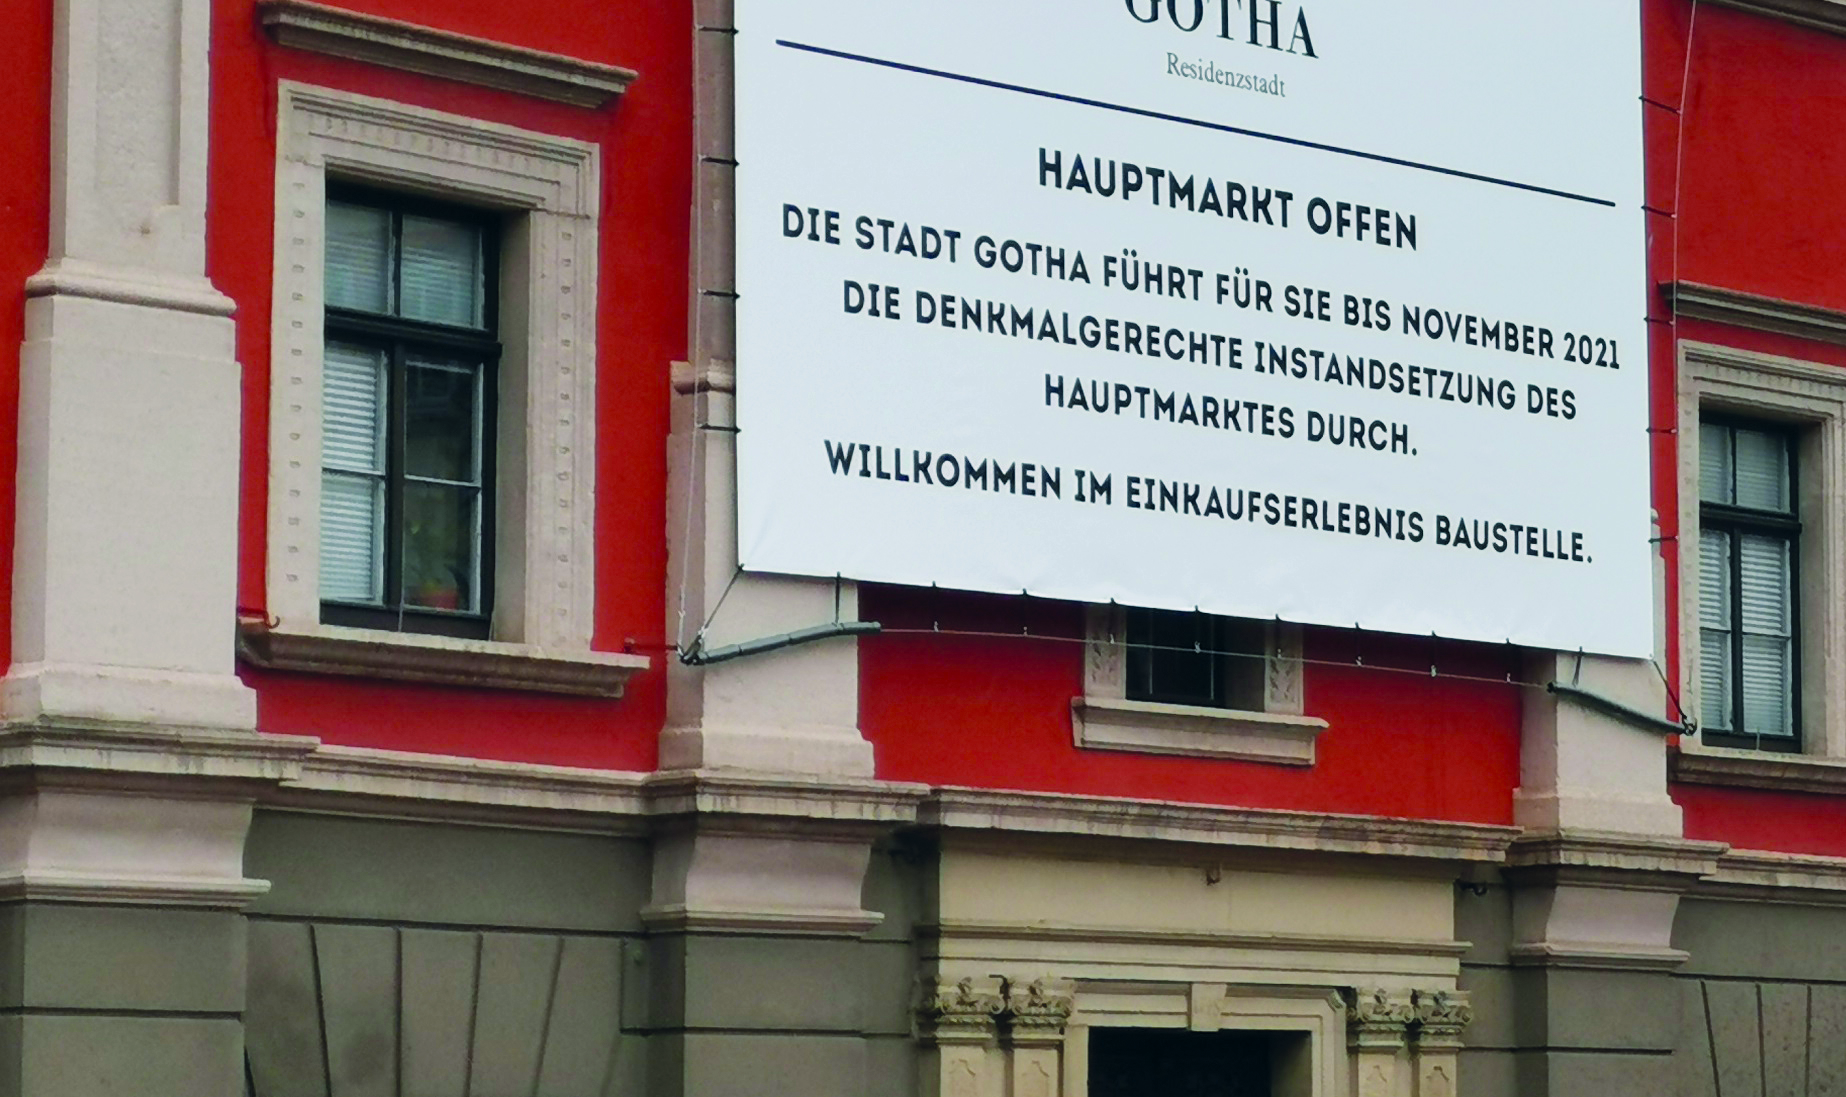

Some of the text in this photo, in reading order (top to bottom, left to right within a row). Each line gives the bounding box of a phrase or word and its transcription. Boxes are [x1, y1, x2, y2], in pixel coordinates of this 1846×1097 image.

[1165, 51, 1286, 100] Residenzstadt
[1038, 147, 1417, 251] HAUPTMARKT OFFEN
[782, 203, 1620, 370] DIE STADT GOTHA FÜHRT FÜR SIE BIS NOVEMBER 2021
[843, 279, 1577, 420] DIE DENKMALGERECHTE INSTANDSETZUNG DES
[1045, 373, 1418, 457] HAUPTMARKTES DURCH.
[823, 439, 1593, 564] WILLKOMMEN IM EINKAUFSERLEBNIS BAUSTELLE.
